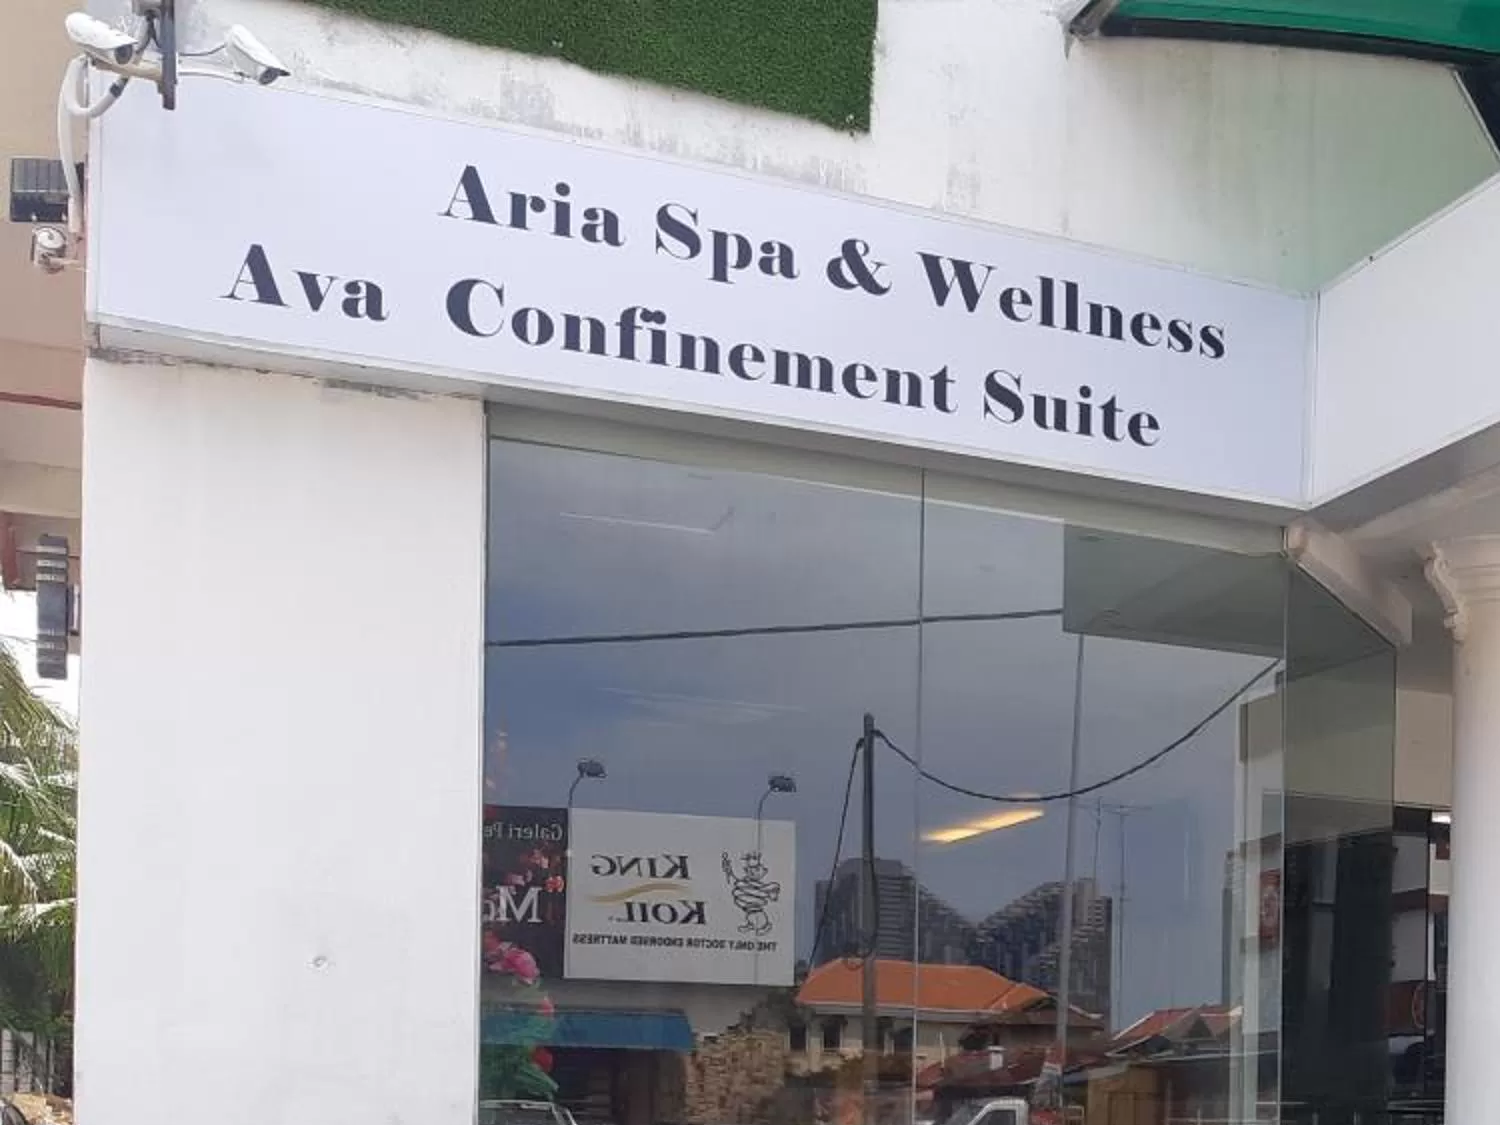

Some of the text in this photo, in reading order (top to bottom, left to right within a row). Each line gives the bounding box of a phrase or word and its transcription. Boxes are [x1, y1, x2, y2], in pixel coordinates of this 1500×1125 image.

[219, 243, 1162, 448] Ava Confinement Suite
[439, 163, 1228, 361] Aria Spa & Wellness
